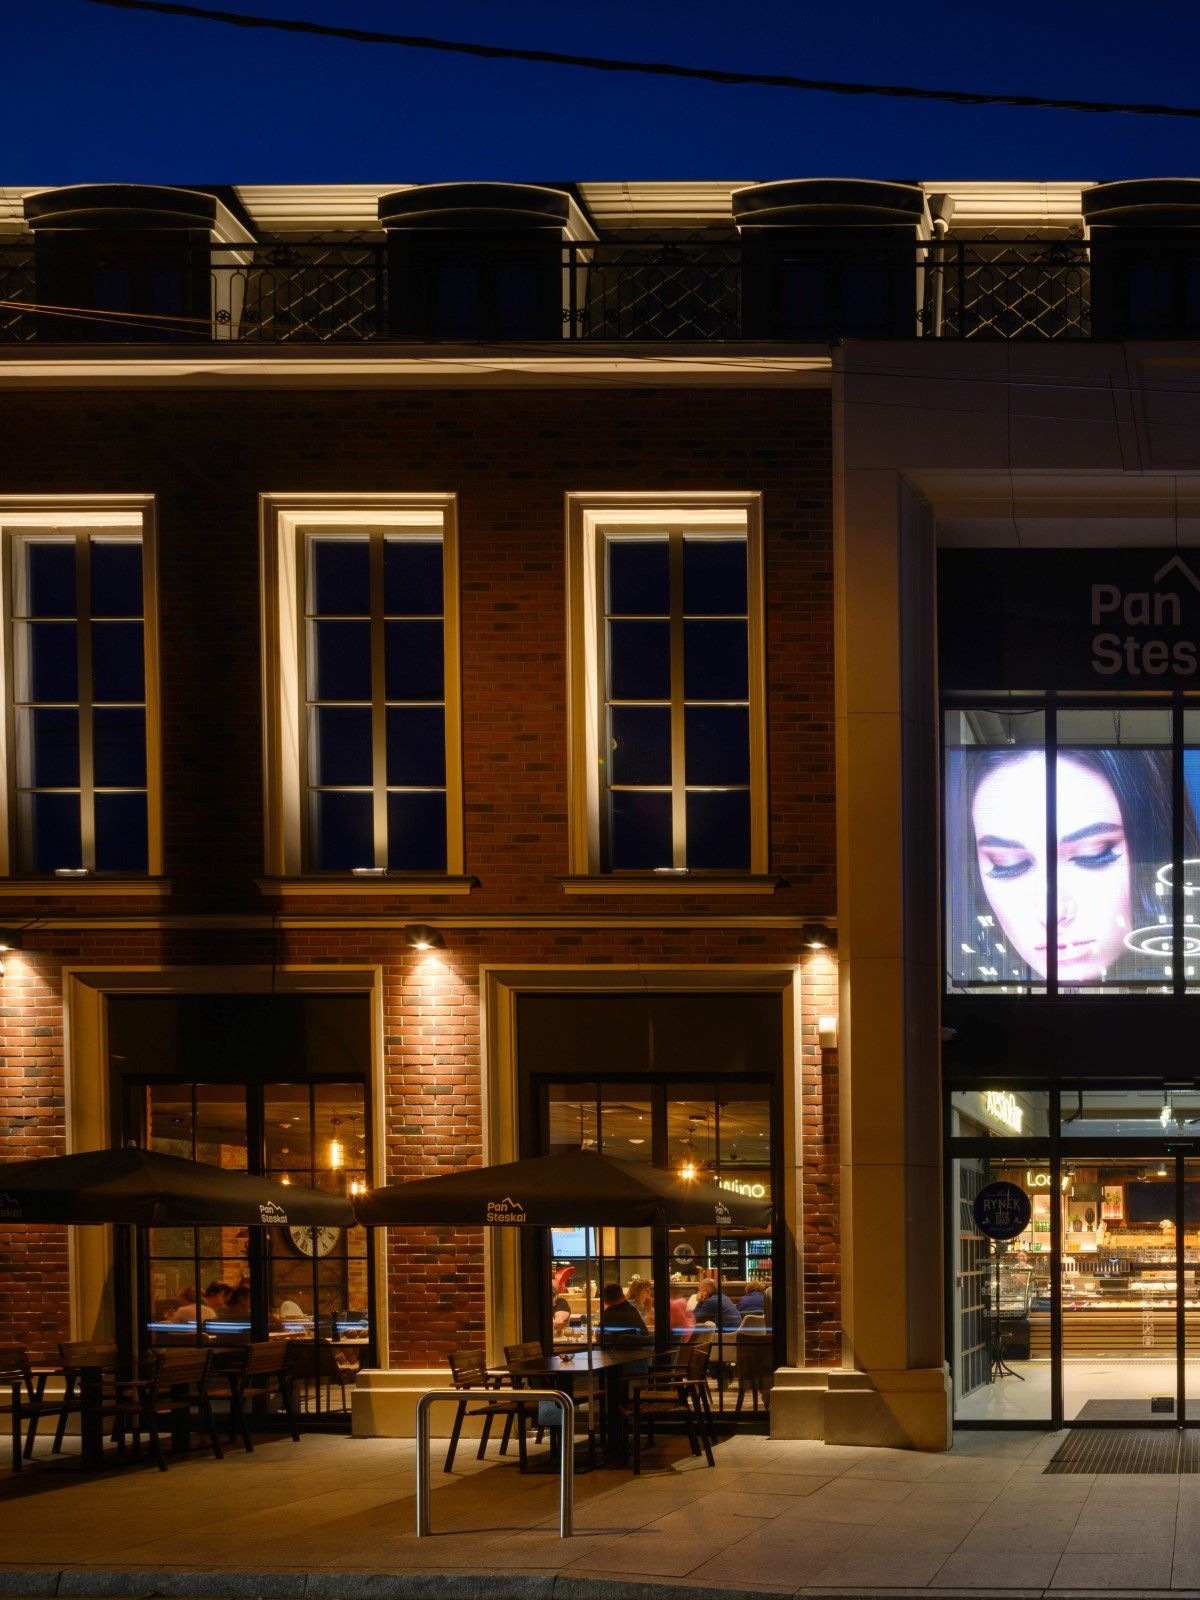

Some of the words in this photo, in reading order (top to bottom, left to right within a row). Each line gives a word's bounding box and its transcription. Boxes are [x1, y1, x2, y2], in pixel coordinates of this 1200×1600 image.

[1091, 584, 1181, 625] Pan
[1027, 1171, 1069, 1191] Loy
[259, 1204, 274, 1213] Pan
[487, 1202, 508, 1211] Pan
[983, 1198, 1021, 1212] RYNEK
[261, 1214, 288, 1223] Steskal
[487, 1212, 526, 1222] Steskal
